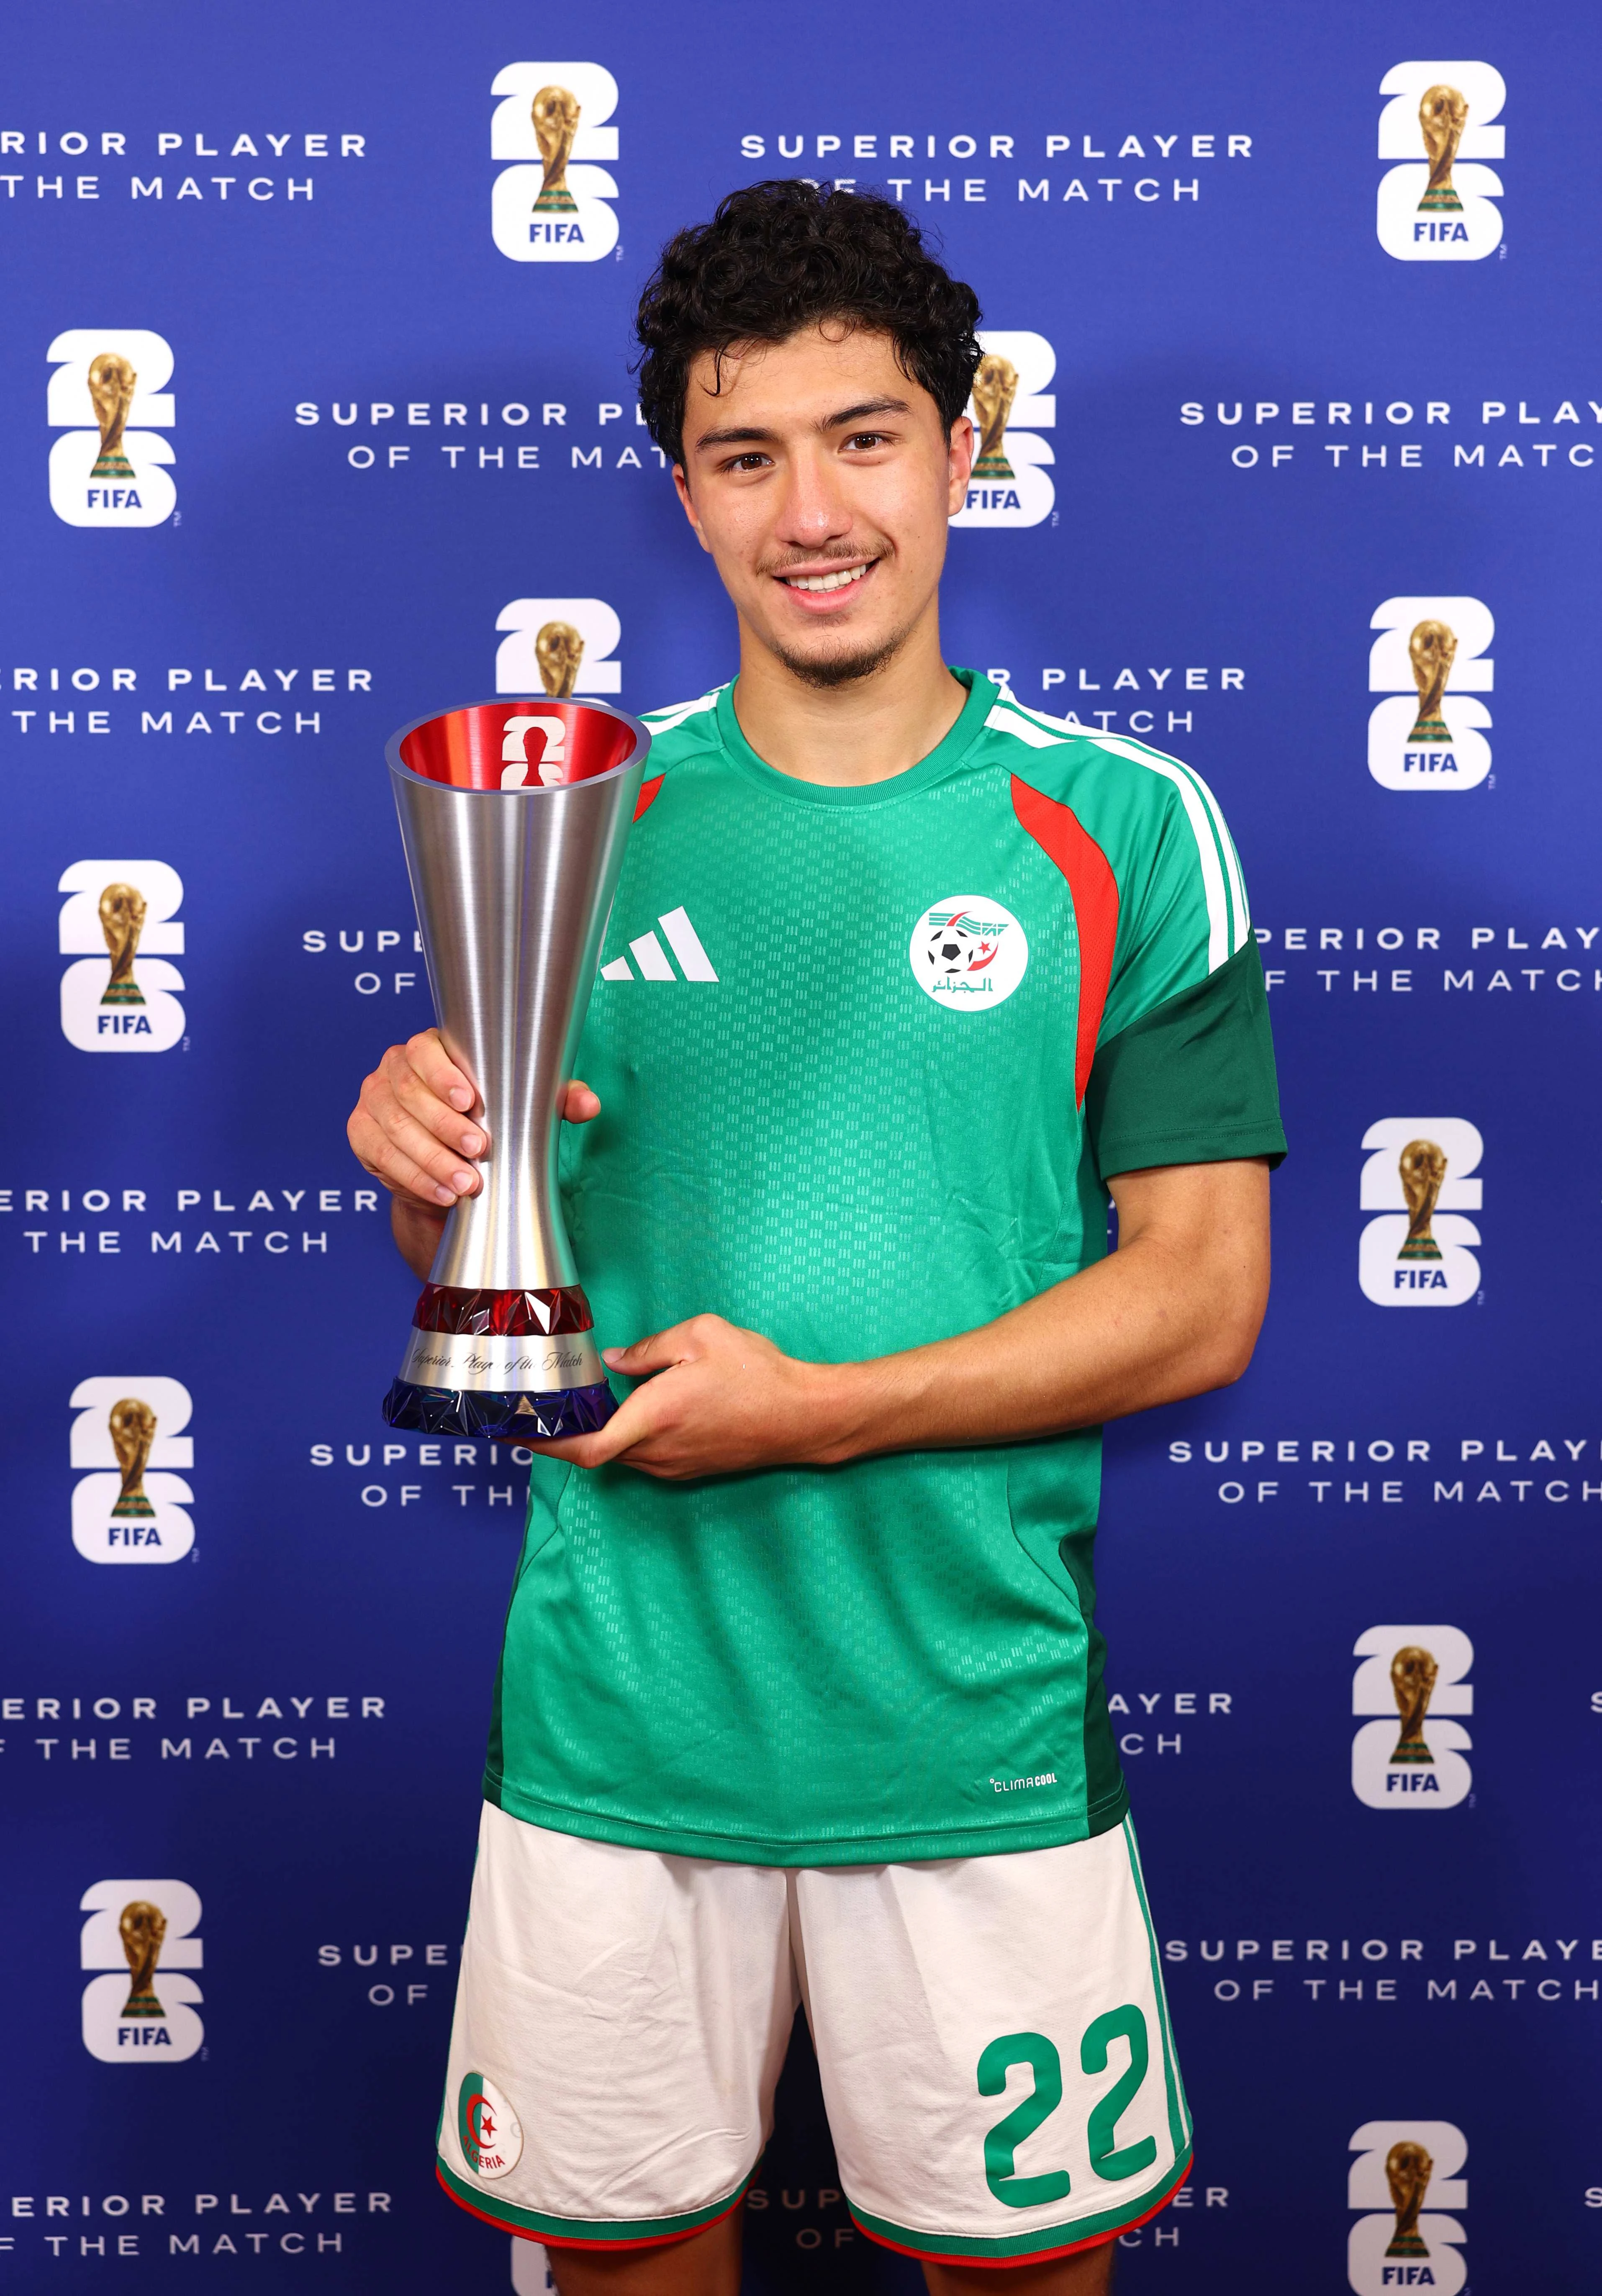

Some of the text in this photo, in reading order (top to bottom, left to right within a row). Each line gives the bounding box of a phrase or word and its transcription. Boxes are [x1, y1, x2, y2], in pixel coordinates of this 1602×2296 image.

[0, 131, 365, 157] RIOR PLAYER
[740, 134, 1253, 159] SUPERIOR PLAYER
[0, 175, 313, 201] THE MATCH
[887, 178, 986, 202] THE
[1018, 178, 1199, 202] MATCH
[529, 224, 584, 243] FIFA
[1414, 223, 1468, 241] FIFA
[295, 402, 567, 426] SUPERIOR
[1180, 401, 1602, 426] SUPERIOR PLAY
[347, 445, 666, 469] OF THE MAT
[1231, 444, 1594, 468] OF THE MATC
[87, 490, 142, 508] FIFA
[966, 490, 1021, 509] FIFA
[0, 668, 372, 692] RIOR PLAYER
[1042, 668, 1245, 691] PLAYER
[11, 710, 320, 735] THE MATCH
[1040, 710, 1192, 733] ATCH
[1404, 753, 1458, 772] FIFA
[1254, 927, 1600, 950] PERIOR PLAY
[354, 972, 416, 995] OF
[932, 976, 993, 994] الجزائر
[1316, 970, 1412, 992] THE
[98, 1015, 152, 1034] FIFA
[0, 1189, 378, 1212] ERIOR PLAYER
[23, 1231, 327, 1253] THE MATCH
[1394, 1270, 1448, 1289] FIFA
[411, 1348, 452, 1369] Superior
[503, 1356, 529, 1375] of
[542, 1351, 583, 1371] Match
[310, 1444, 533, 1466] SUPERIO
[1168, 1439, 1602, 1463] SUPERIOR PLAY
[361, 1484, 530, 1507] OF TH
[1218, 1480, 1602, 1504] OF THE MATCH
[109, 1528, 162, 1546] FIFA
[2, 1697, 385, 1720] ERIOR PLAYER
[1108, 1693, 1232, 1715] AYER
[35, 1737, 335, 1760] THE MATCH
[1386, 1773, 1440, 1792] FIFA
[1166, 1939, 1423, 1962] SUPERIOR
[368, 1984, 428, 2006] OF
[1214, 1979, 1599, 2001] OF THE MATCH
[118, 2027, 172, 2046] FIFA
[977, 2004, 1157, 2208] 22
[462, 2135, 506, 2170] ALGERIA
[12, 2192, 391, 2217] ERIOR PLAYER
[44, 2232, 341, 2257] THE MATCH
[796, 2228, 855, 2249] OF
[1382, 2266, 1435, 2286] FIFA
